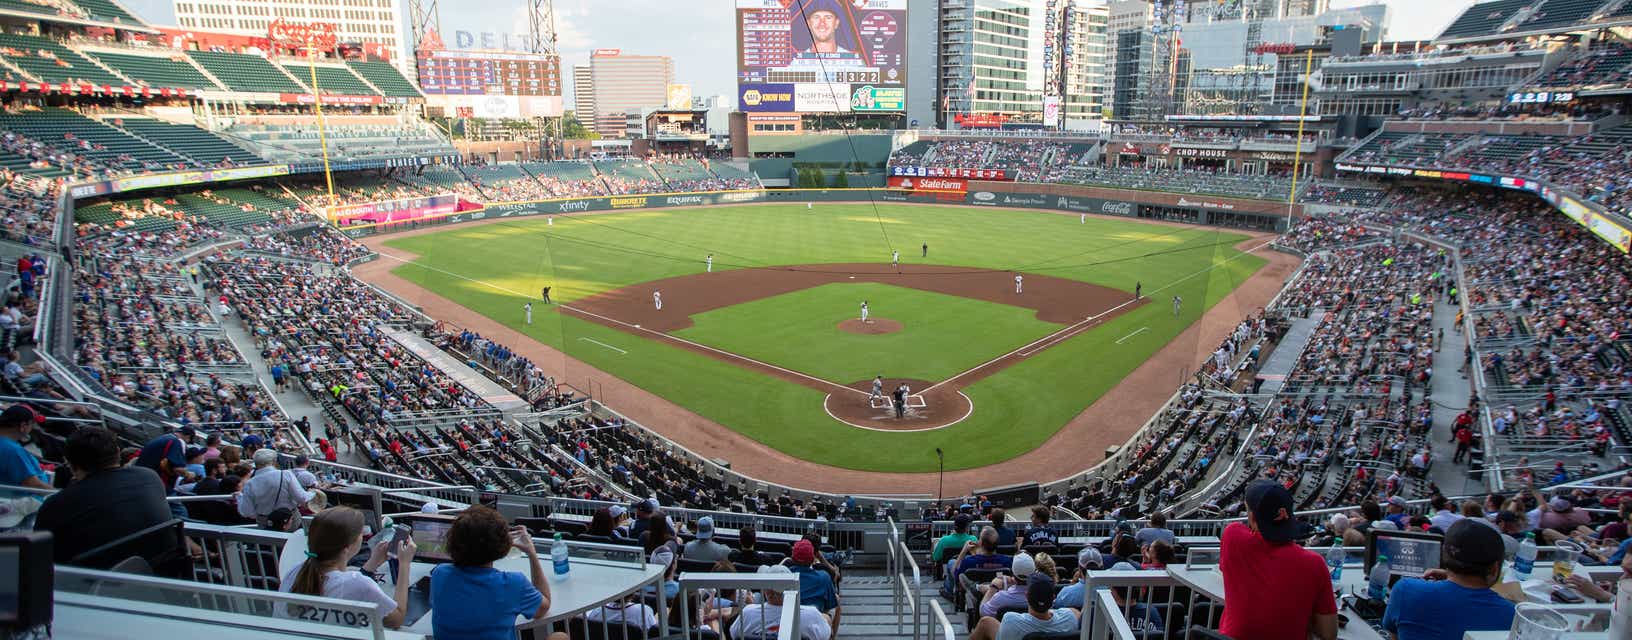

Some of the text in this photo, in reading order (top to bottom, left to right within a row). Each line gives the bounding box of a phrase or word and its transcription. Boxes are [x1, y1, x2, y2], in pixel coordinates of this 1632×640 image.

[848, 73, 878, 82] 3 2 2
[919, 179, 961, 190] State Farm
[666, 196, 702, 205] EQUIFAX
[559, 200, 590, 212] xfinity
